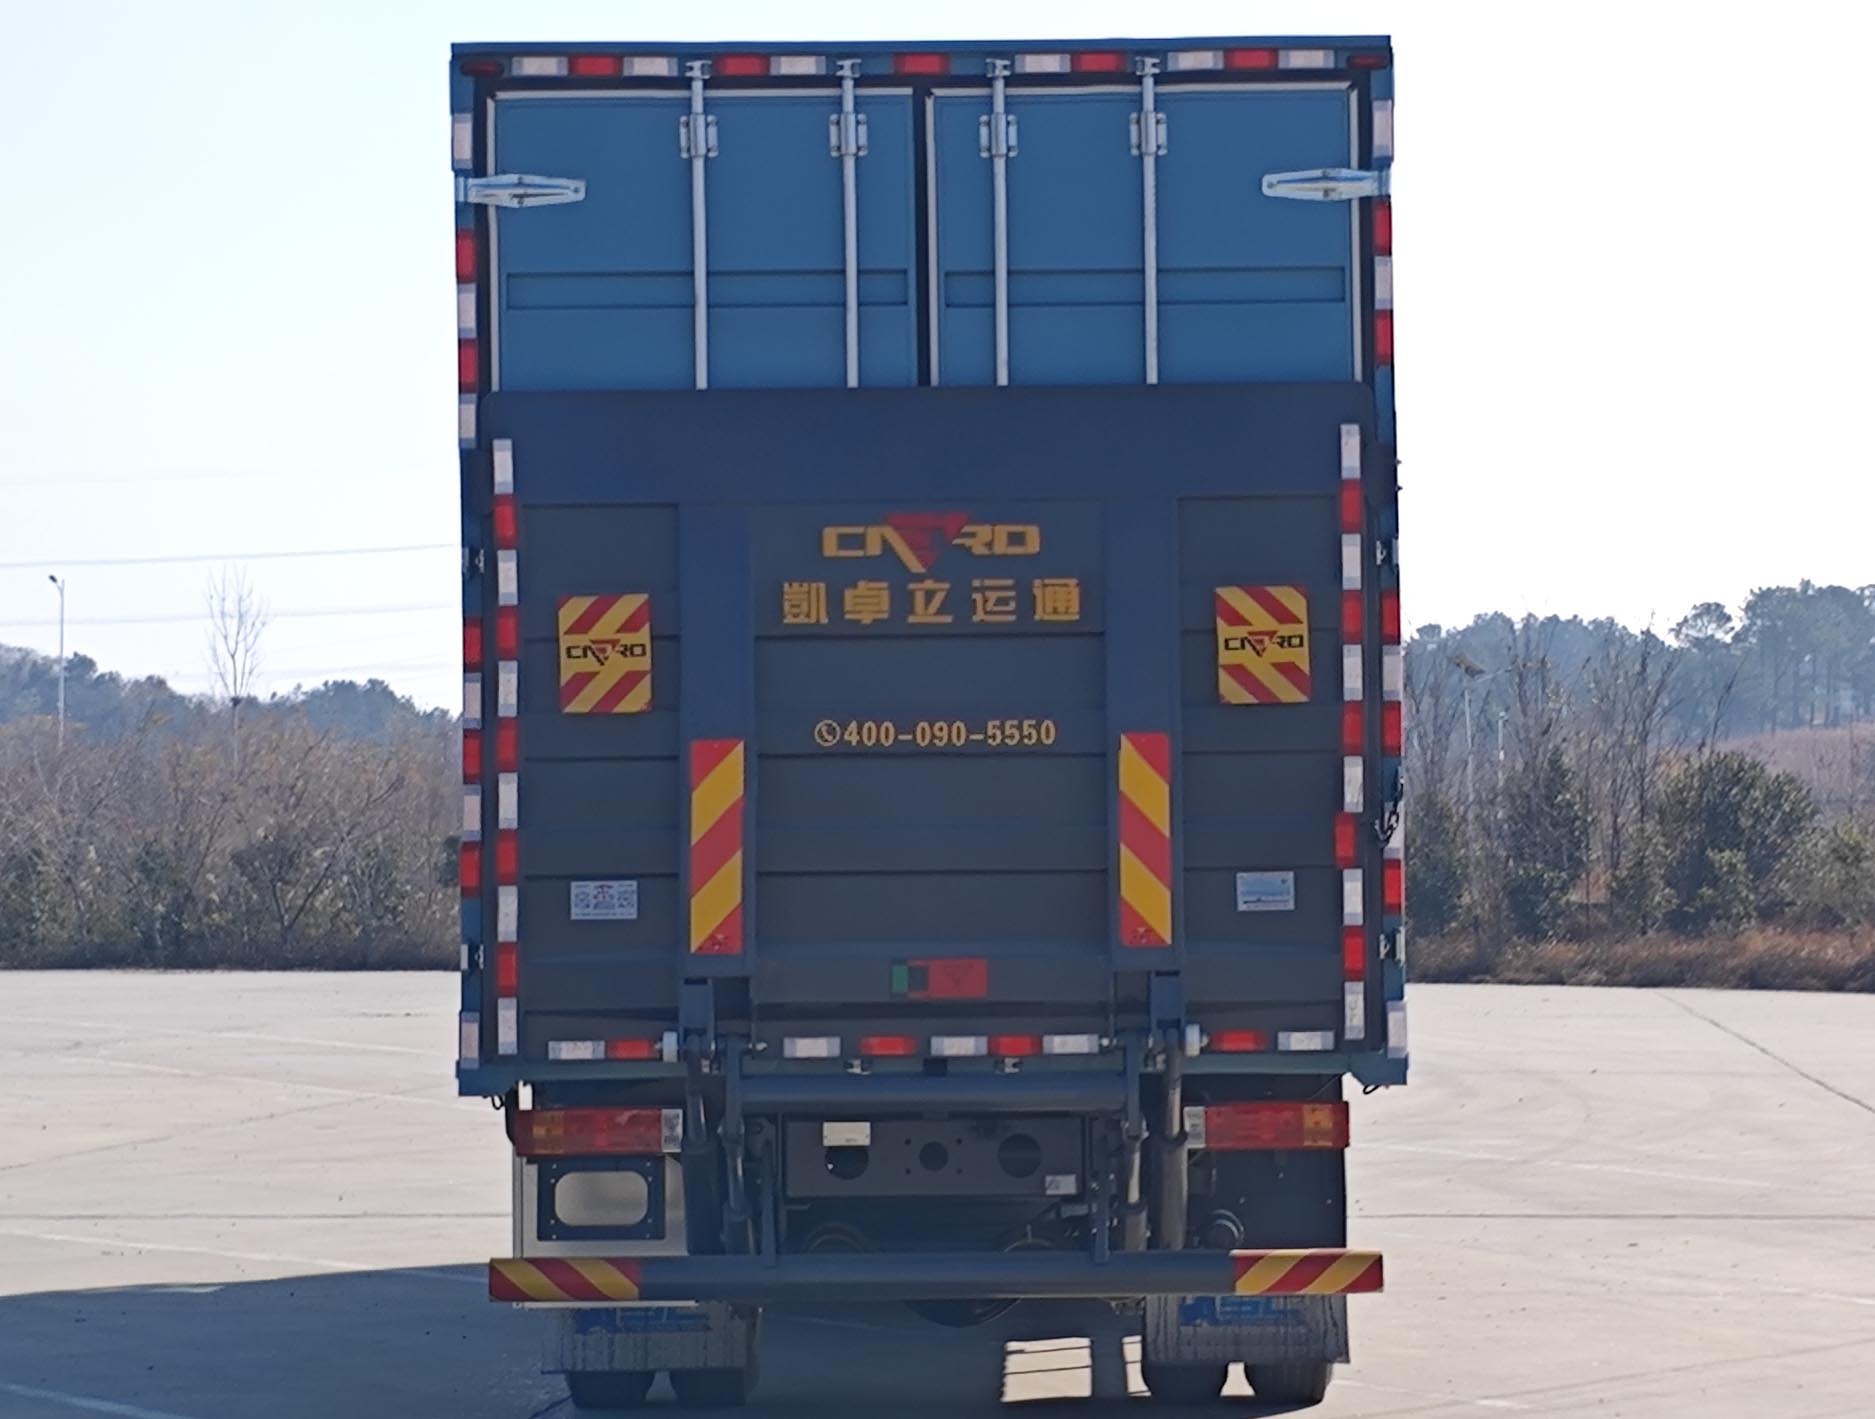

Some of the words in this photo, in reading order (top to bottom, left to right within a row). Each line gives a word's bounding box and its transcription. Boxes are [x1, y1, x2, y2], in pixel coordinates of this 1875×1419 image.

[783, 578, 1081, 625] 凯卓立运通
[843, 720, 1056, 747] 400-090-5550
